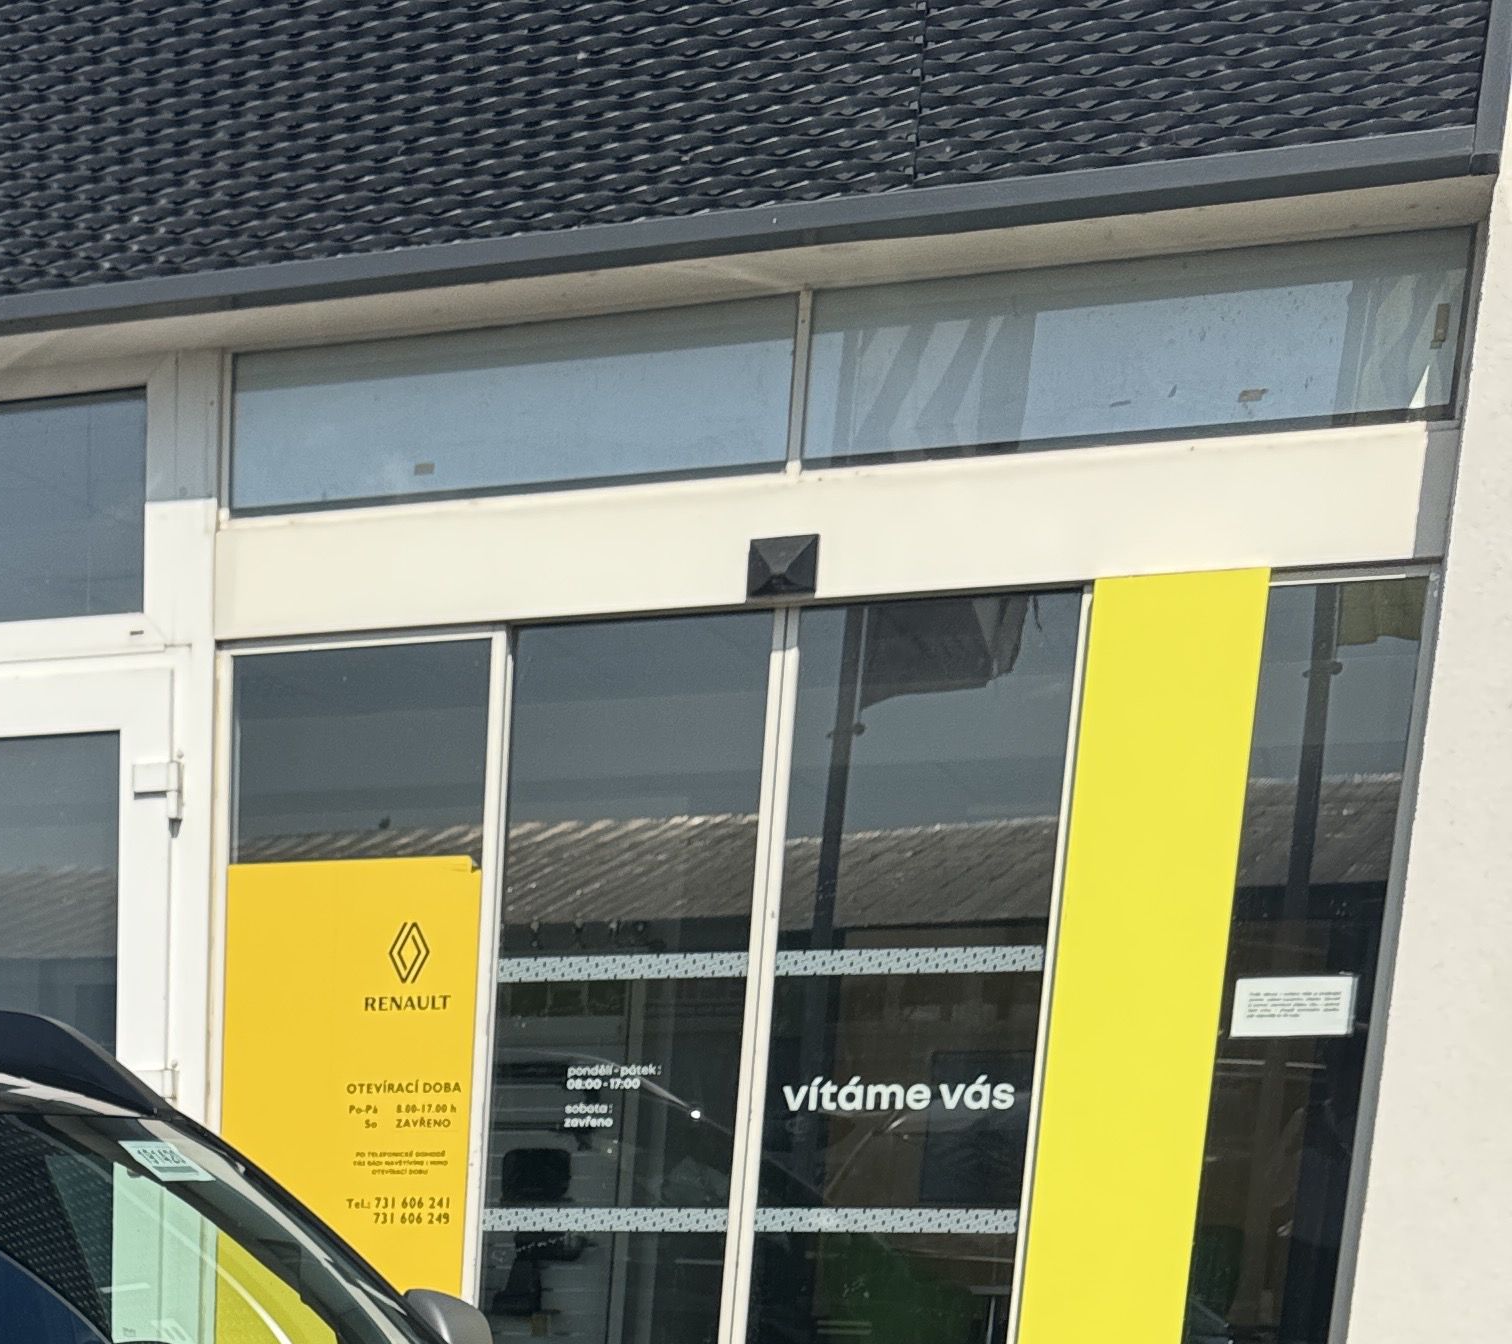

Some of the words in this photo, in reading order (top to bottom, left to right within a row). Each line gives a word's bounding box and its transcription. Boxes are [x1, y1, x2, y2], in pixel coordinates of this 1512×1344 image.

[364, 994, 452, 1012] RENAULT
[346, 1079, 420, 1094] OTEVÍRACÍ
[422, 1081, 462, 1094] DOBA
[783, 1076, 932, 1111] vítáme
[939, 1074, 1016, 1110] vás
[450, 1103, 457, 1113] h
[364, 1119, 378, 1129] So
[395, 1116, 451, 1129] ZAVŘENO
[374, 1197, 395, 1209] 731
[401, 1196, 424, 1209] 606
[428, 1196, 450, 1209] 241
[373, 1212, 394, 1224] 731
[400, 1212, 423, 1224] 606
[427, 1212, 450, 1224] 249
